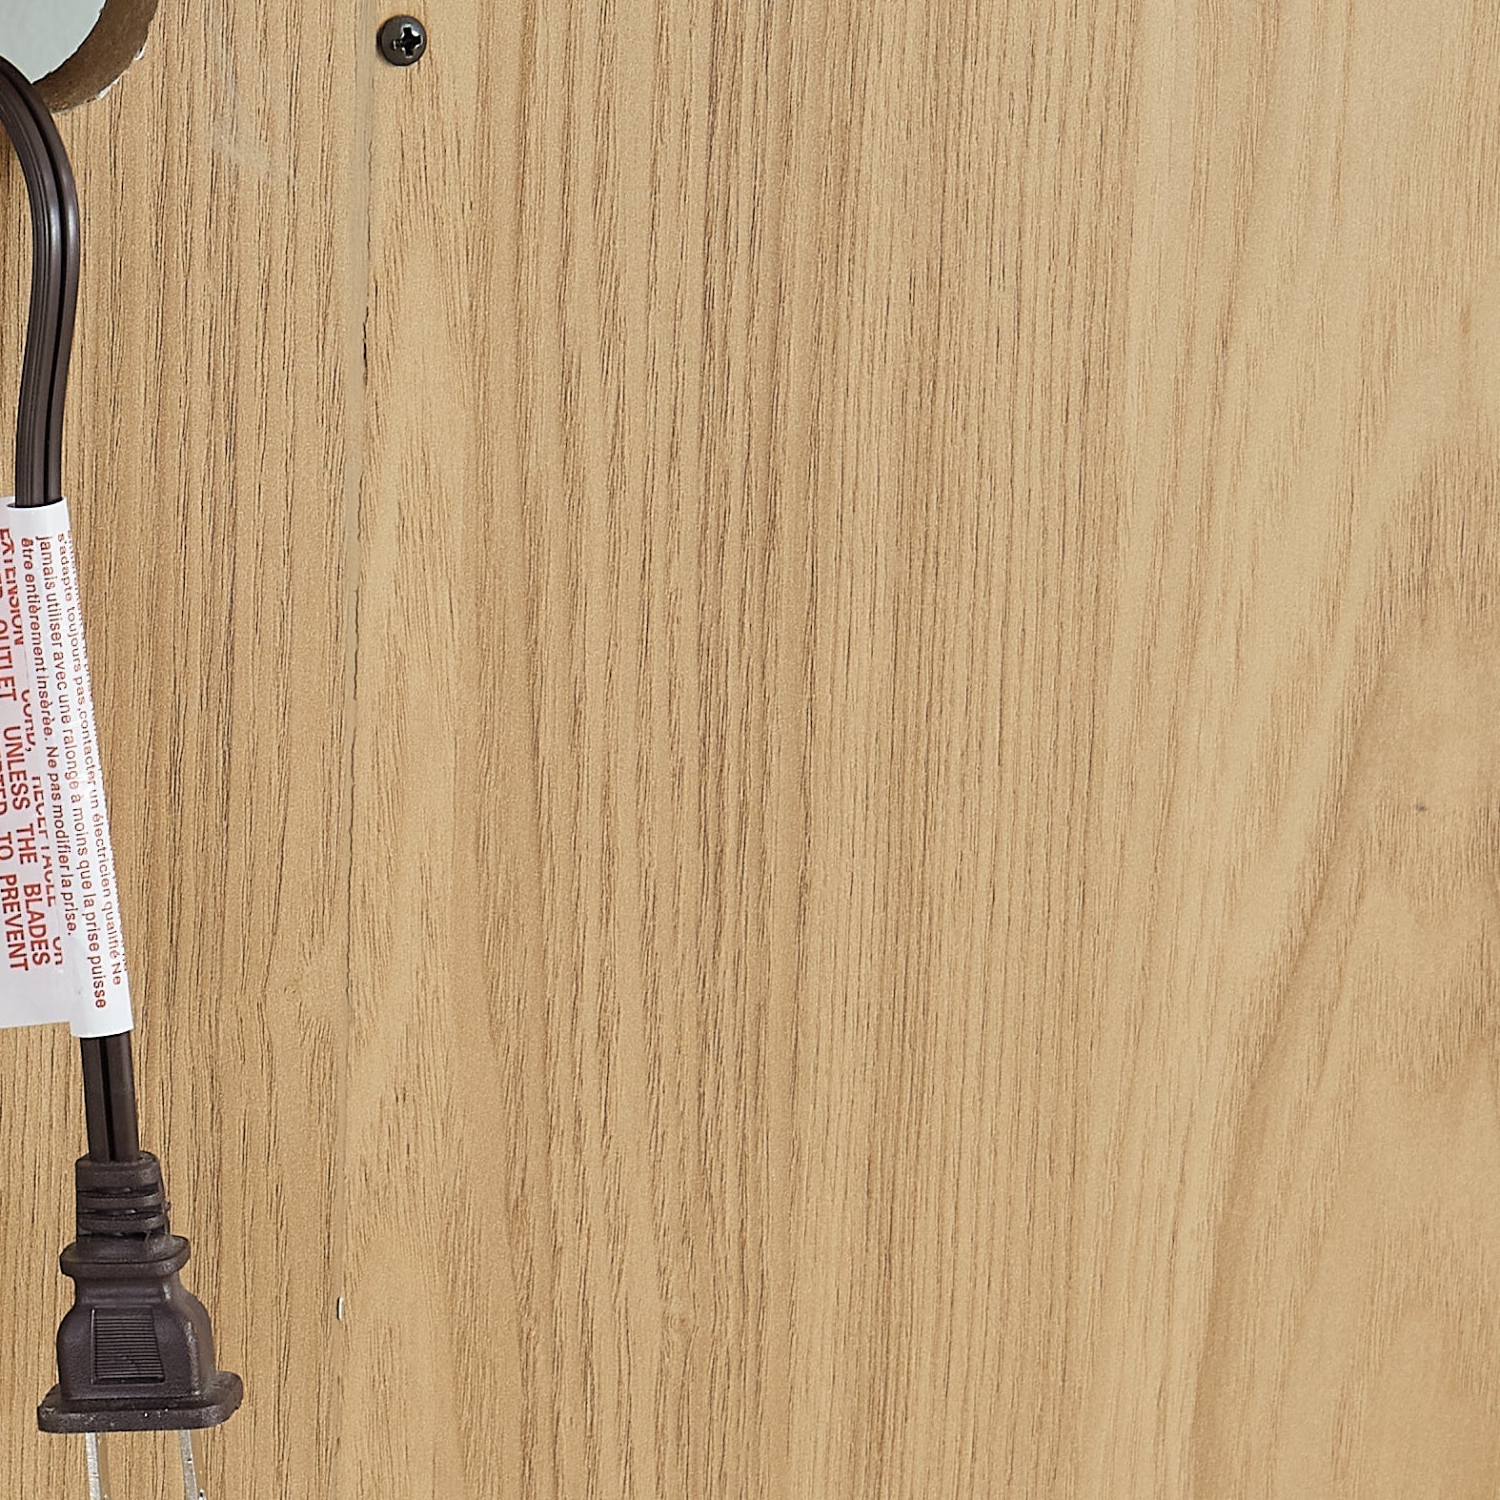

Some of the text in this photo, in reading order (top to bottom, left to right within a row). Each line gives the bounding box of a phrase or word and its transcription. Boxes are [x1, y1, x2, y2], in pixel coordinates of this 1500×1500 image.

[2, 725, 31, 811] UNLESS
[15, 822, 39, 866] THE
[22, 882, 51, 966] BLADES
